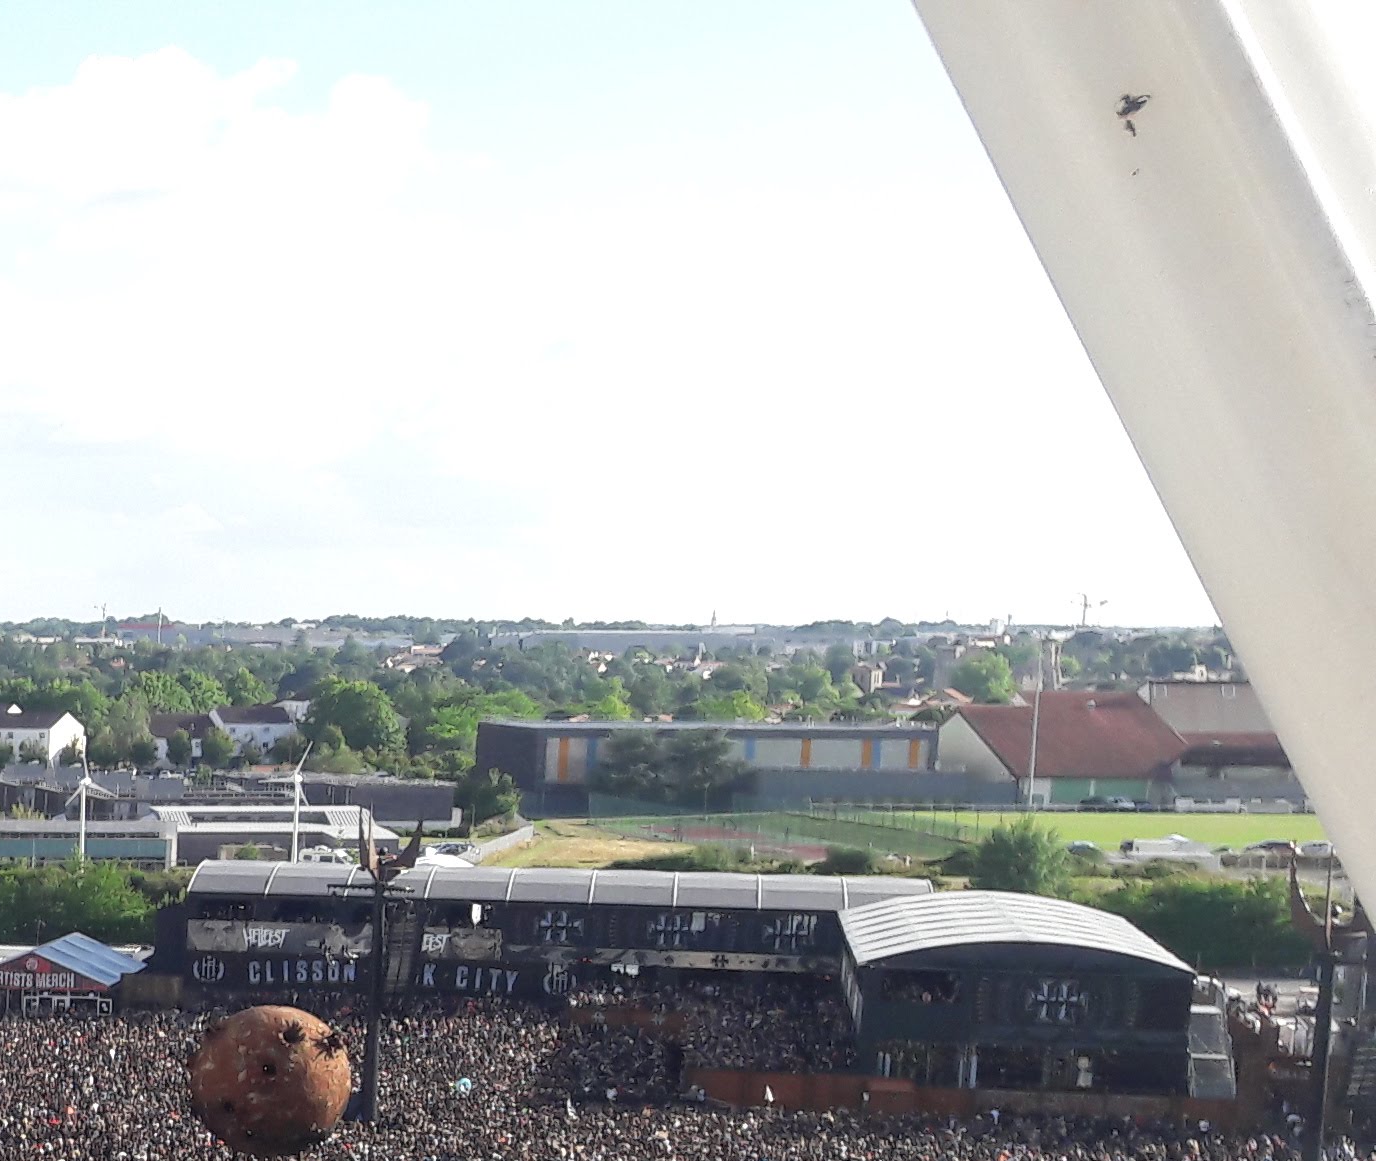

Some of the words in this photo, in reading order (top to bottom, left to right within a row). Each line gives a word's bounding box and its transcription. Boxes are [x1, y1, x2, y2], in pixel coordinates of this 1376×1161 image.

[35, 973, 75, 990] MERCH
[249, 959, 356, 985] CLISSON
[455, 965, 519, 992] CITY
